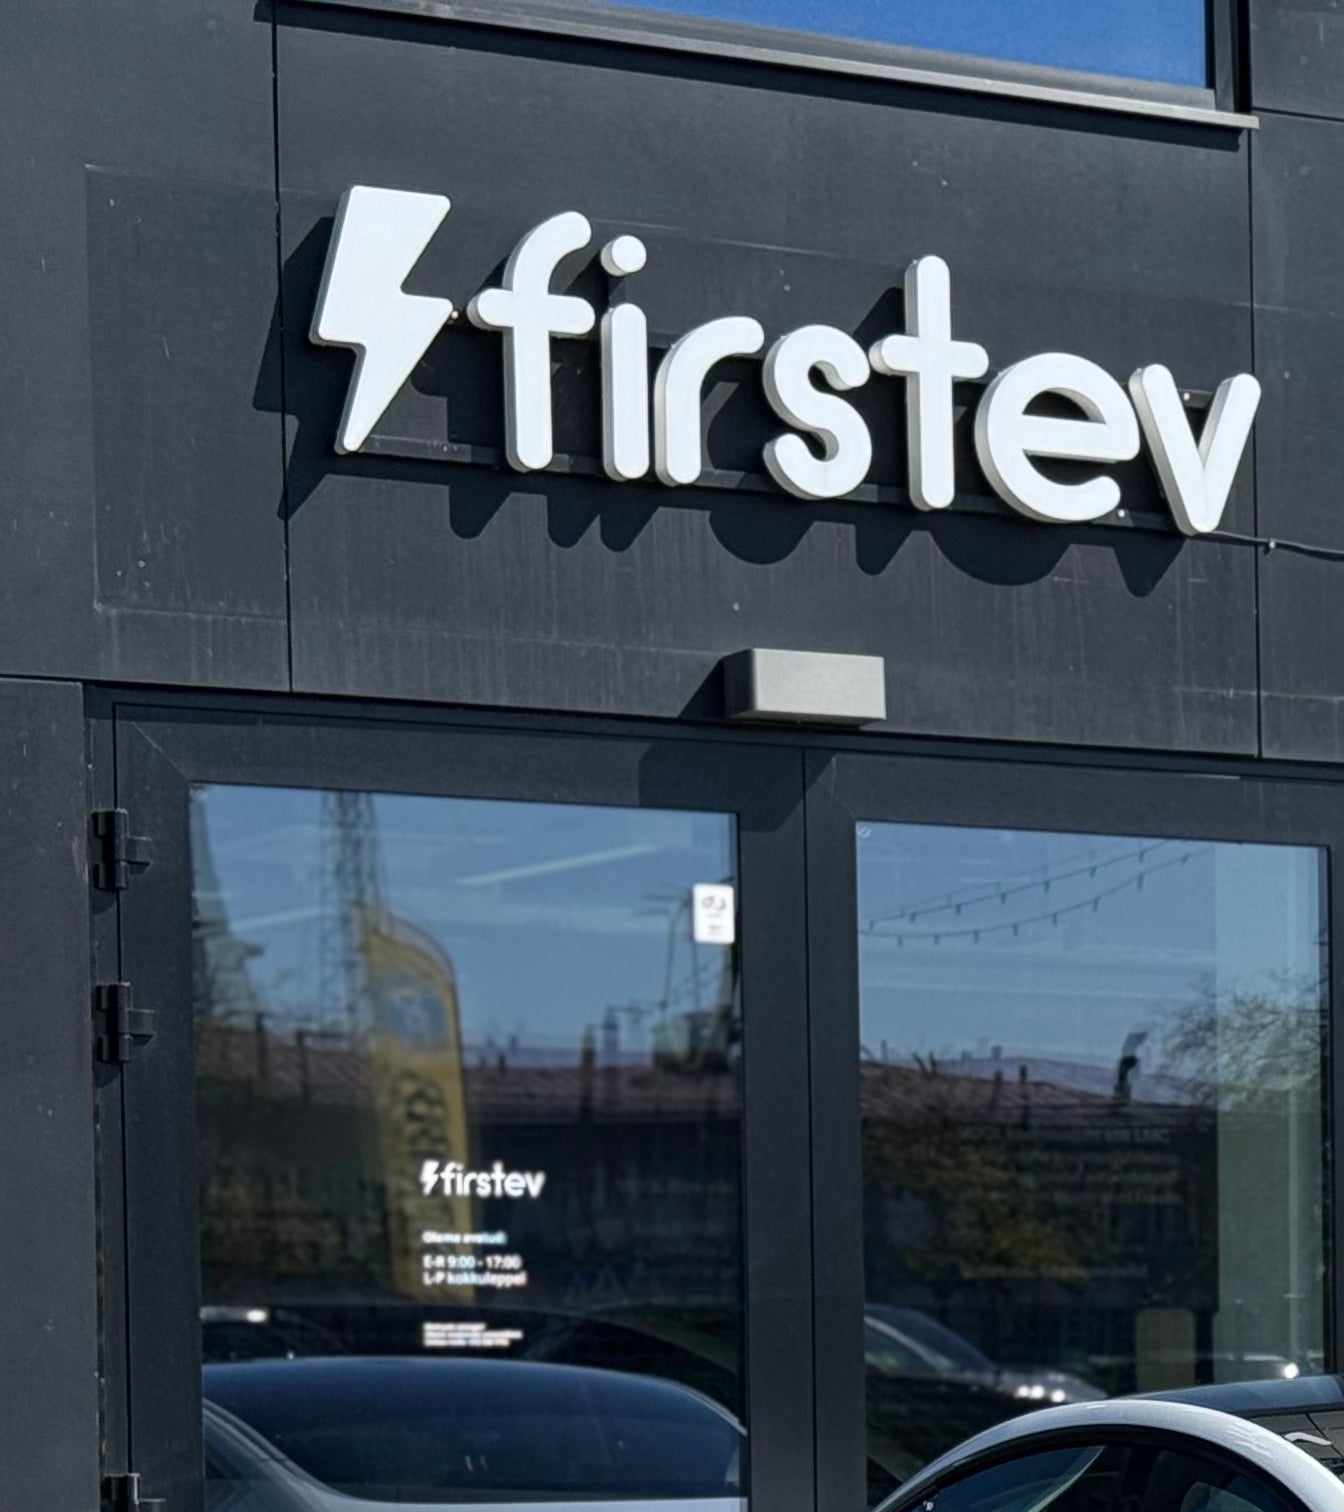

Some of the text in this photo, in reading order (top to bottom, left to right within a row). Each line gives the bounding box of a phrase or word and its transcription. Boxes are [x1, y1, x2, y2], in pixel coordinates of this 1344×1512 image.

[467, 211, 1261, 536] firstev
[441, 1161, 545, 1197] firstev
[447, 1255, 475, 1269] 9:00
[485, 1255, 522, 1270] 17:00
